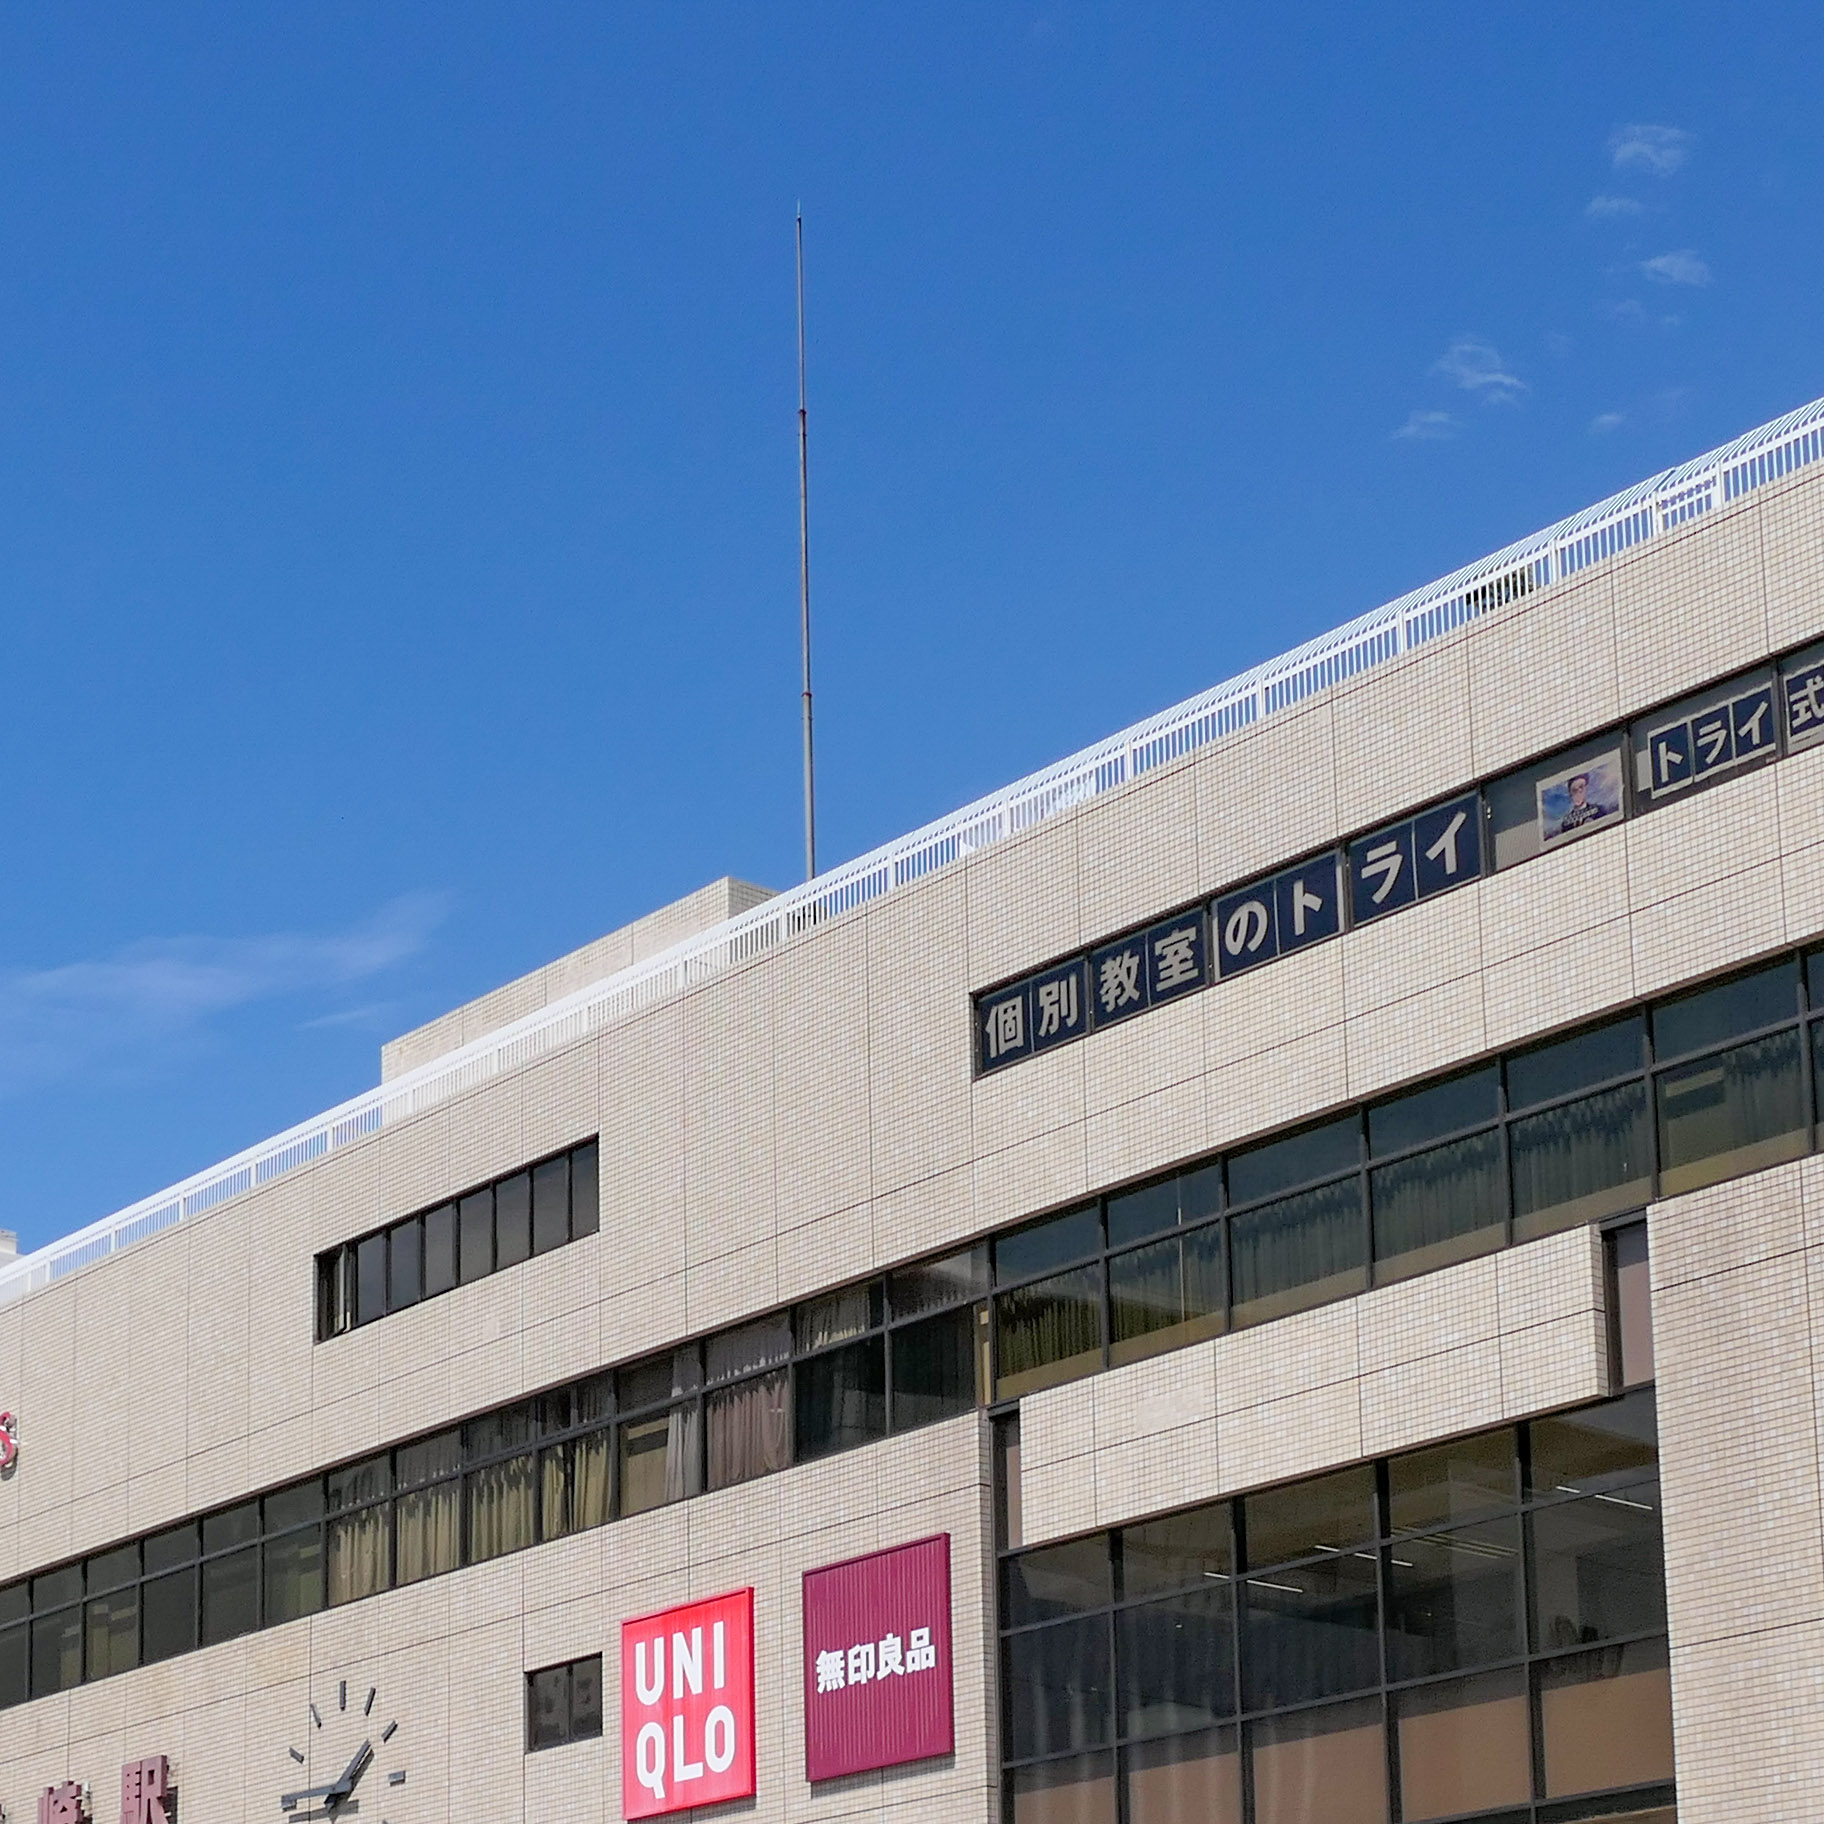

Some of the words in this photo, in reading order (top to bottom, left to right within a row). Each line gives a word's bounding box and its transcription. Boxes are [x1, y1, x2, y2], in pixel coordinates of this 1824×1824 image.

[983, 811, 1468, 1060] 個別教室のトライ
[634, 1620, 726, 1706] UNI
[816, 1627, 938, 1694] 無印良品
[635, 1704, 736, 1799] QLO
